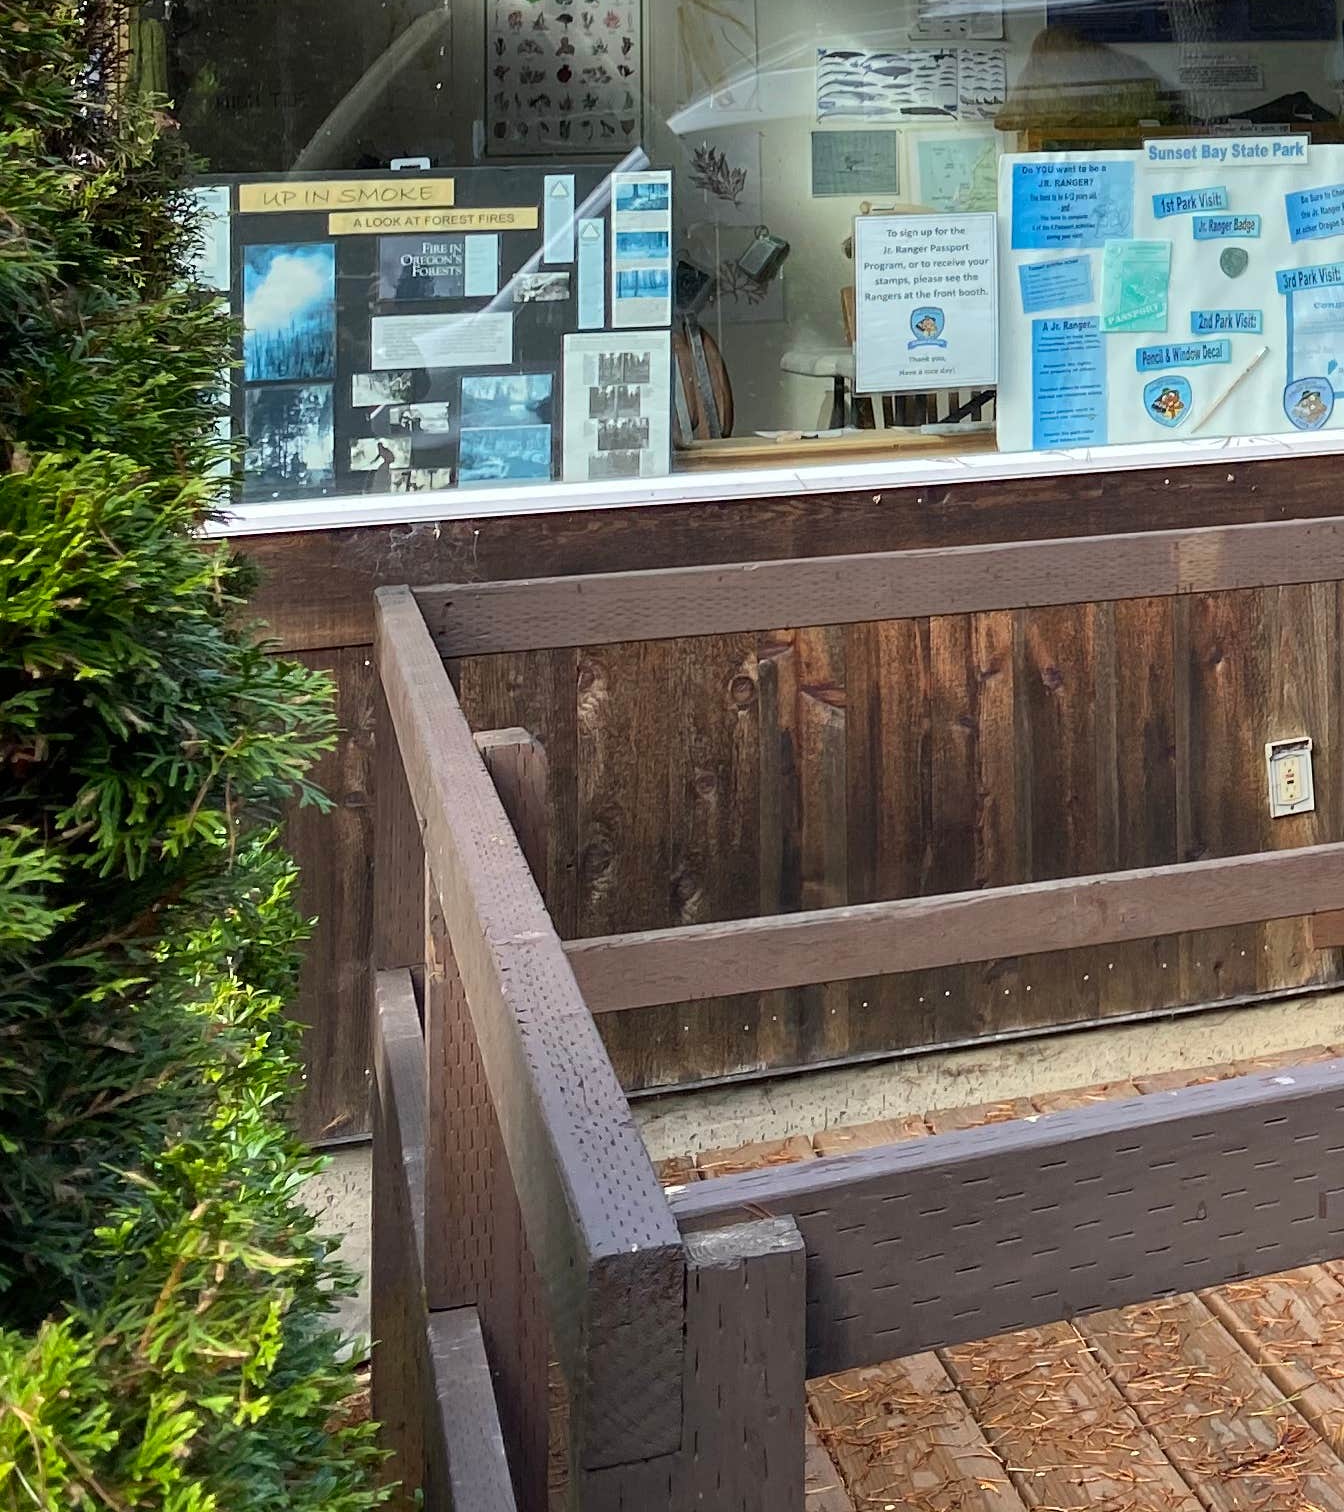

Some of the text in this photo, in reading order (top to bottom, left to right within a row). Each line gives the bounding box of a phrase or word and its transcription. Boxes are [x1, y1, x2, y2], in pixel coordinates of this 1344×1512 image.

[1149, 141, 1304, 162] Sunset Bay State Park
[1036, 166, 1054, 174] YOU
[1078, 165, 1086, 173] to
[1055, 178, 1094, 187] RANGER?
[264, 185, 433, 206] UP IN SMOKE
[1161, 194, 1222, 213] 1st Park Visit:
[353, 214, 515, 227] A LOOK AT FOREST FIRES
[1199, 218, 1255, 234] Jr. Ranger Badge
[886, 227, 966, 238] To sign up for the
[422, 242, 463, 254] FIRE IN
[884, 243, 970, 255] Jr. Ranger Passport
[412, 265, 462, 277] FORESTS
[864, 262, 906, 271] Program,
[933, 258, 966, 266] receive
[968, 259, 989, 267] your
[875, 277, 911, 285] stamps,
[914, 275, 942, 284] please
[963, 273, 979, 281] the
[1283, 269, 1341, 288] 3rd Park Visit:
[864, 293, 901, 302] Rangers
[916, 291, 930, 299] the
[933, 290, 956, 298] front
[959, 288, 988, 296] booth.
[1042, 322, 1048, 331] A
[1051, 322, 1061, 330] Jr.
[1199, 313, 1257, 329] 2nd Park Visit:
[1142, 344, 1223, 366] Pencil & Window Decal
